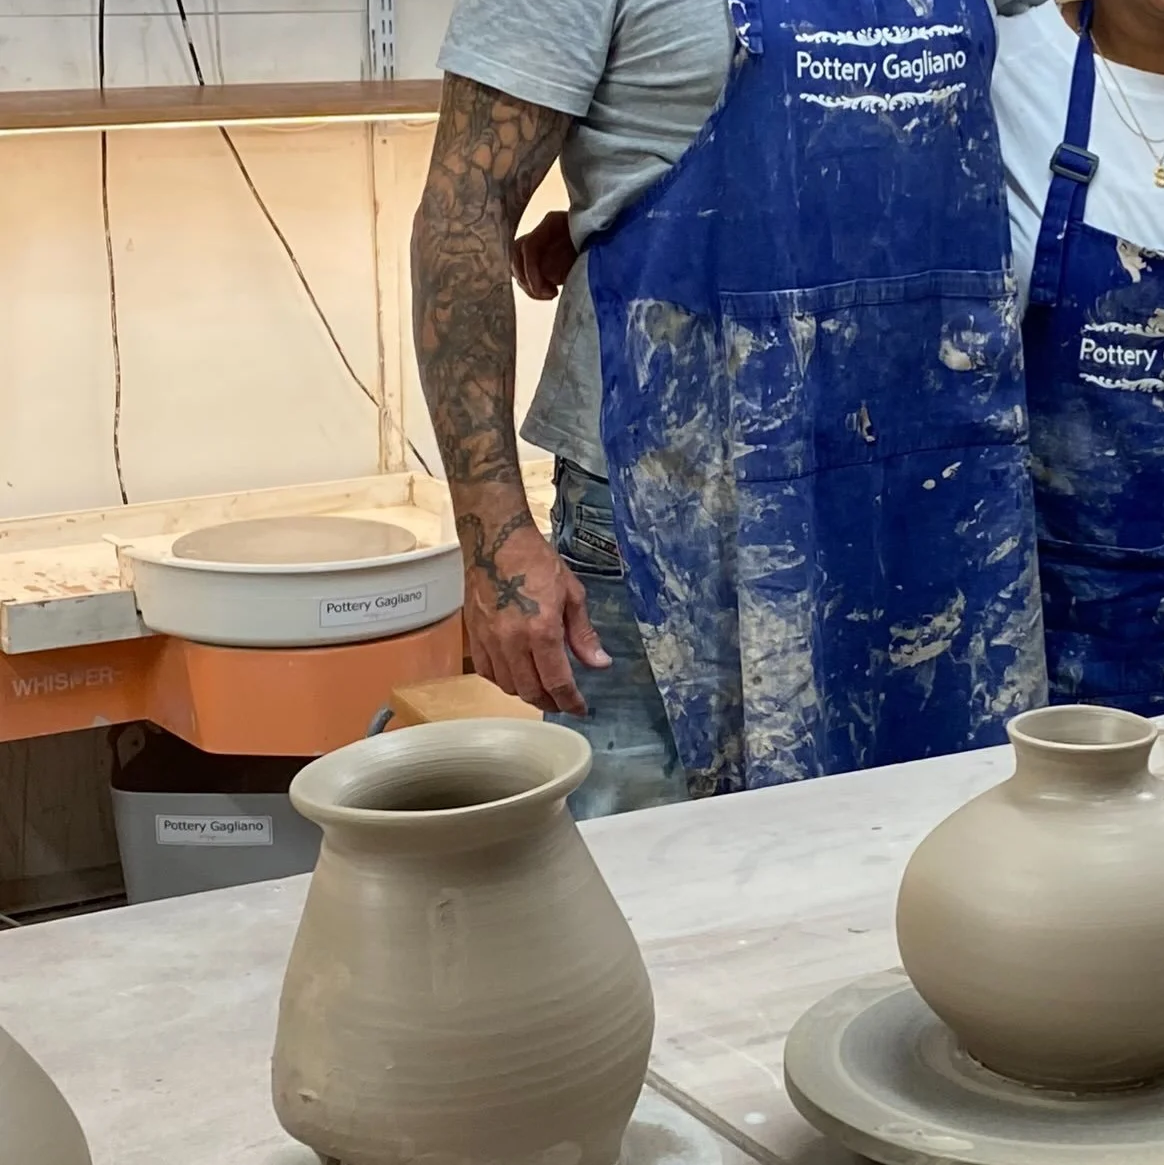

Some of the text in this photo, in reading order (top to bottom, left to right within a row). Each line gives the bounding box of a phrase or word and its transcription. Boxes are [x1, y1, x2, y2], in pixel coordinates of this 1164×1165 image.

[796, 49, 967, 88] Pottery Gagliano
[1079, 337, 1158, 372] Pottery
[326, 590, 423, 614] Pottery Gagliano
[163, 819, 264, 834] Pottery Gagliano
